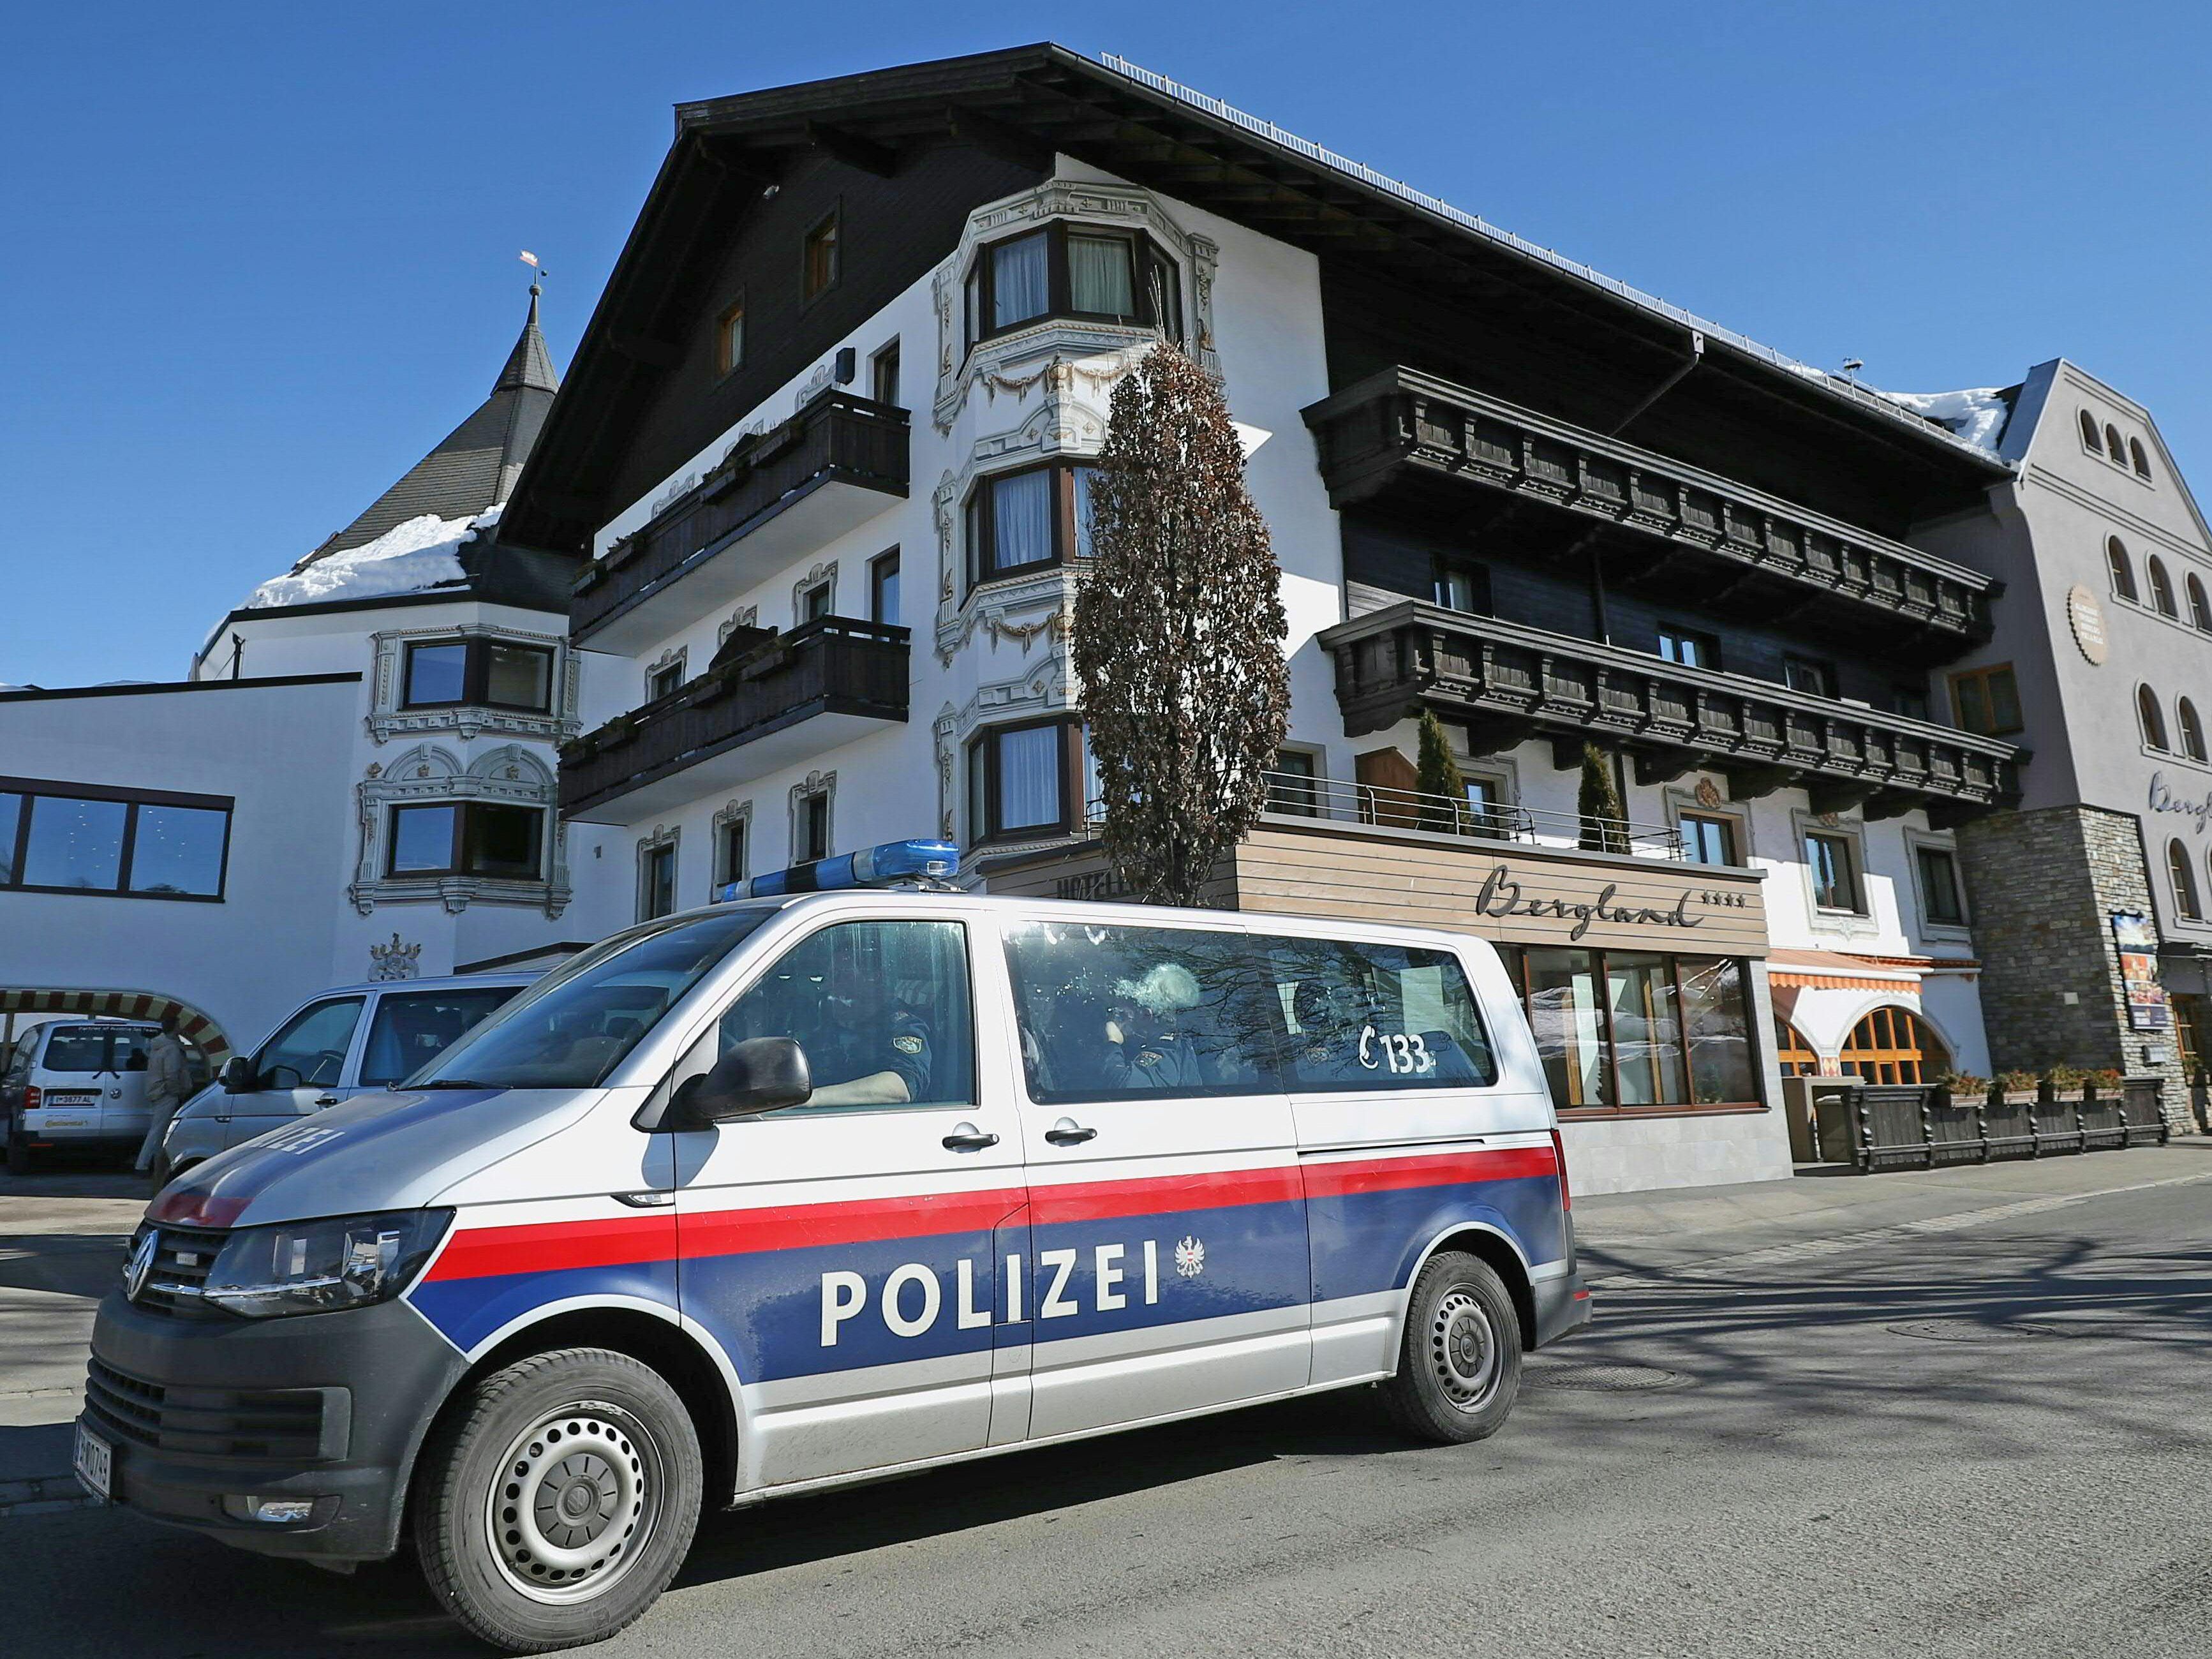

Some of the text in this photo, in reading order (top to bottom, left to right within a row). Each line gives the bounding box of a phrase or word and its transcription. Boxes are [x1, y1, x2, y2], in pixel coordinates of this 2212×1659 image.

[1476, 864, 1705, 941] Bergland
[1379, 1034, 1430, 1073] 133
[820, 1240, 1158, 1347] POLIZEI
